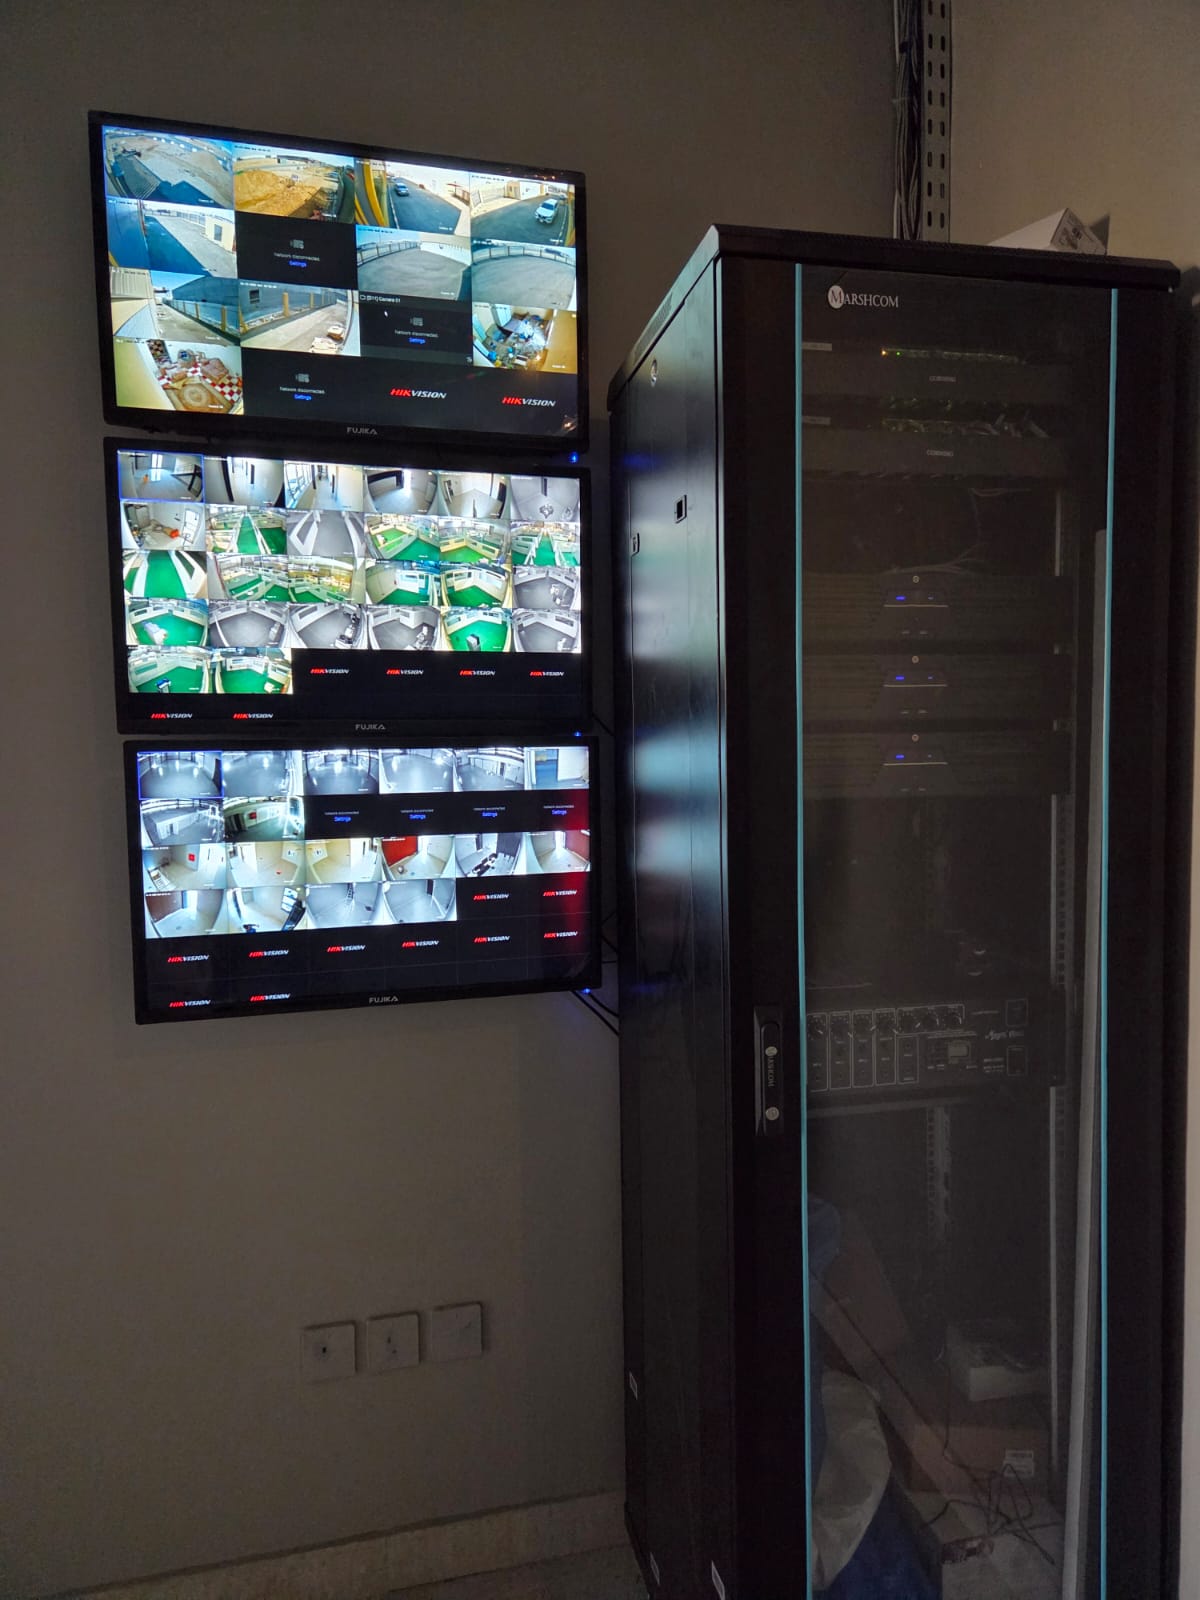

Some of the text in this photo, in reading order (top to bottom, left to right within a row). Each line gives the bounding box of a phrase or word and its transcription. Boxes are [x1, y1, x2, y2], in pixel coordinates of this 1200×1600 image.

[828, 285, 898, 309] MARSHCOM
[390, 387, 447, 399] HIKVISION
[501, 396, 556, 407] HIKVISION
[346, 426, 378, 435] FUJIKA
[355, 723, 386, 731] FUJIKA
[368, 995, 399, 1004] FUJIKA
